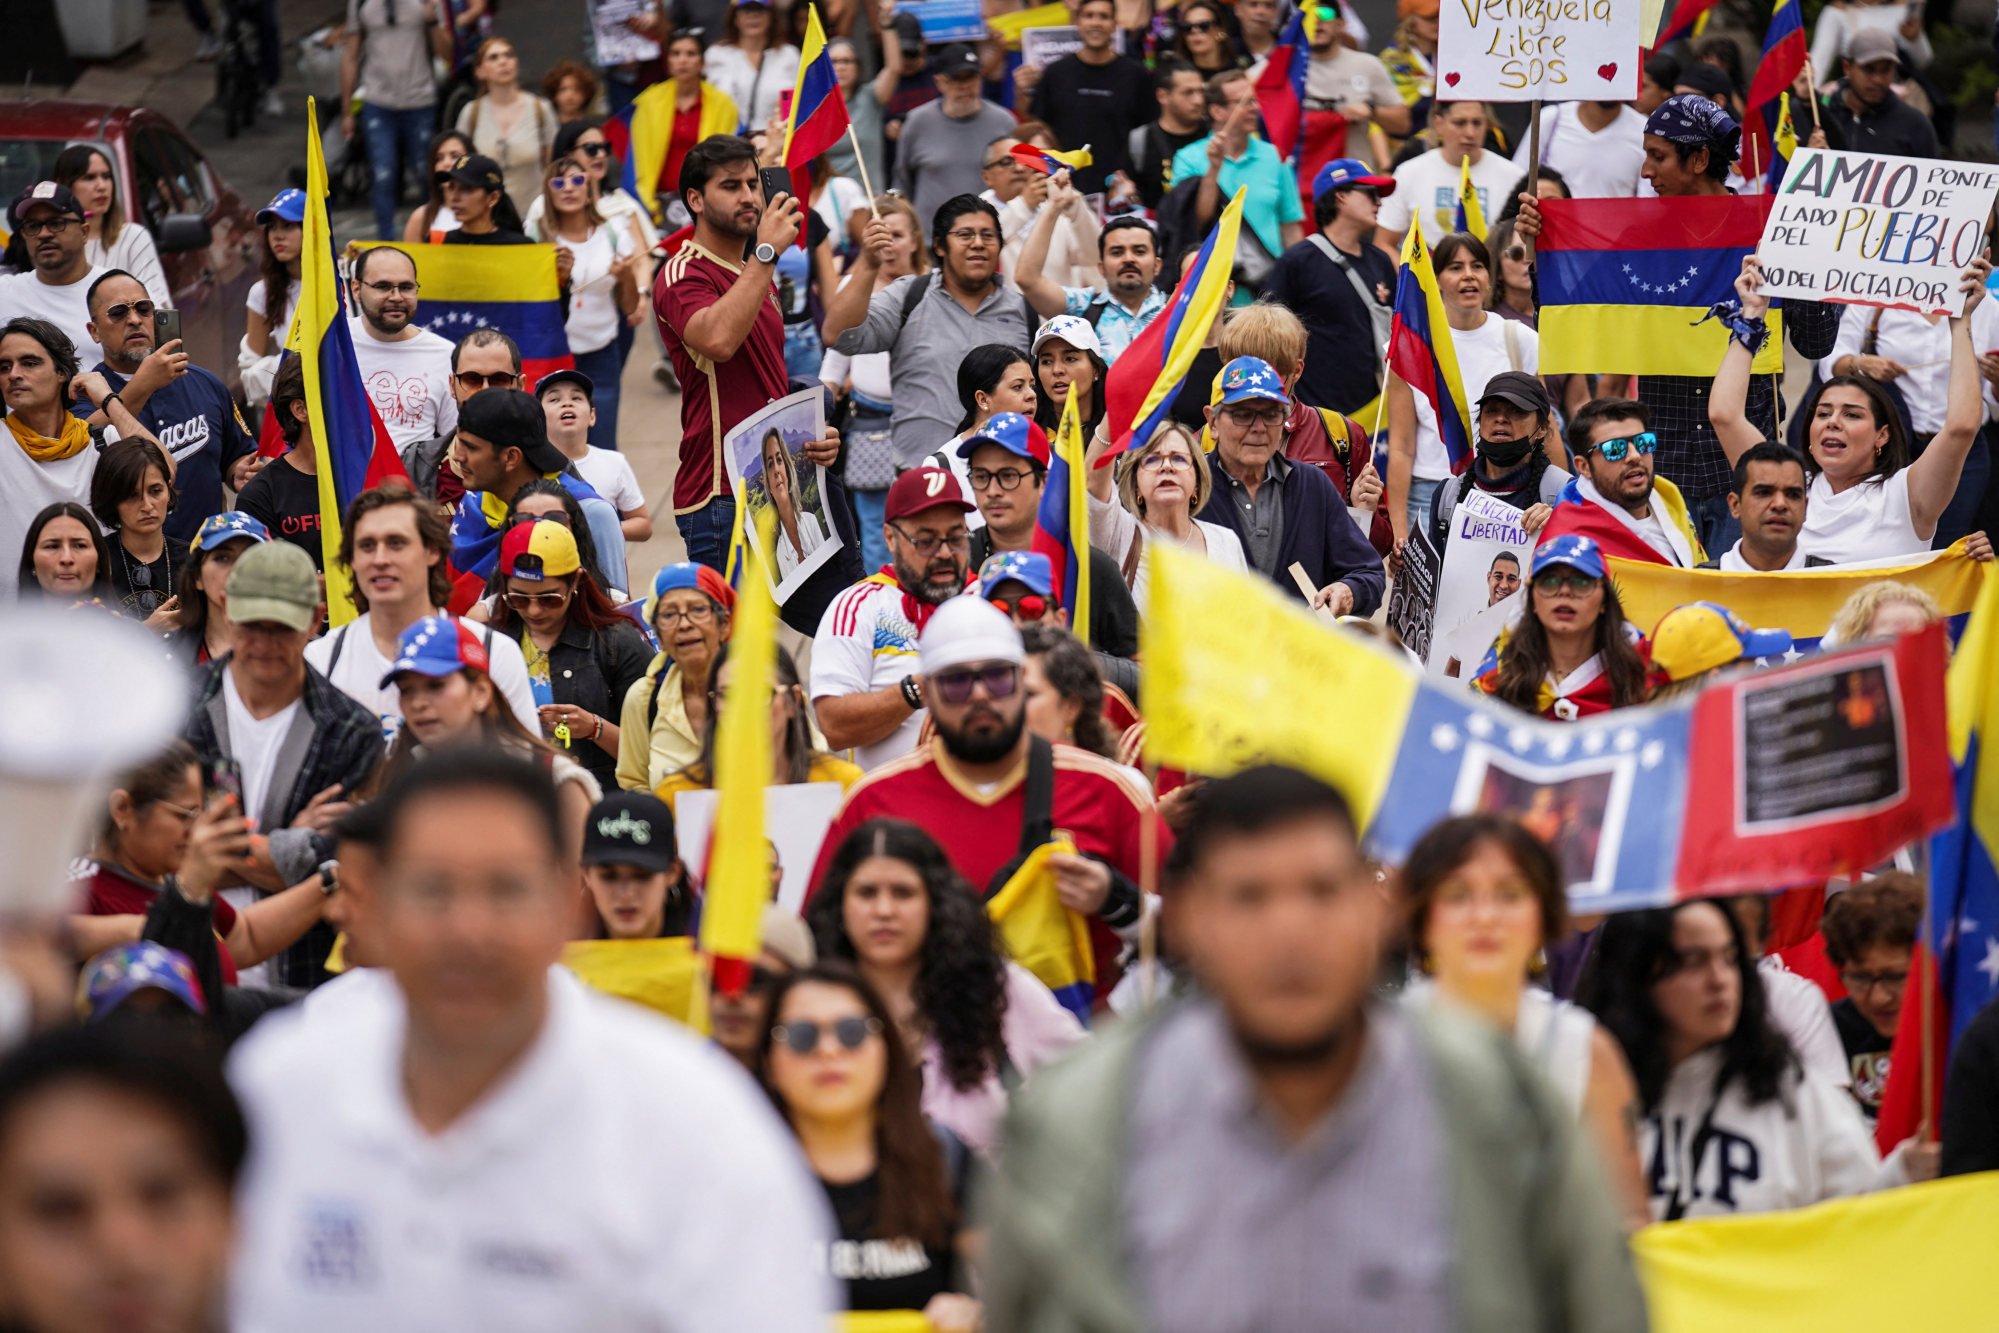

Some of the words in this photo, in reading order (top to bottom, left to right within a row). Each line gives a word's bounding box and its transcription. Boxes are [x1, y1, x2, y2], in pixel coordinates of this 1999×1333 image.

[1462, 0, 1612, 36] Venezuela
[1485, 25, 1567, 58] Libre
[1499, 58, 1568, 89] SOS
[1784, 153, 1919, 209] AMIO
[1927, 167, 1999, 190] PONTE
[1921, 189, 1953, 208] DE
[1779, 205, 1838, 227] LADO
[1770, 226, 1810, 246] DEL
[1834, 206, 1982, 270] PUEBLO
[1787, 269, 1818, 289] DEL
[1824, 268, 1949, 306] DICTADOR
[364, 370, 428, 416] ee
[158, 414, 209, 449] acas
[1412, 537, 1427, 564] EXIGIR
